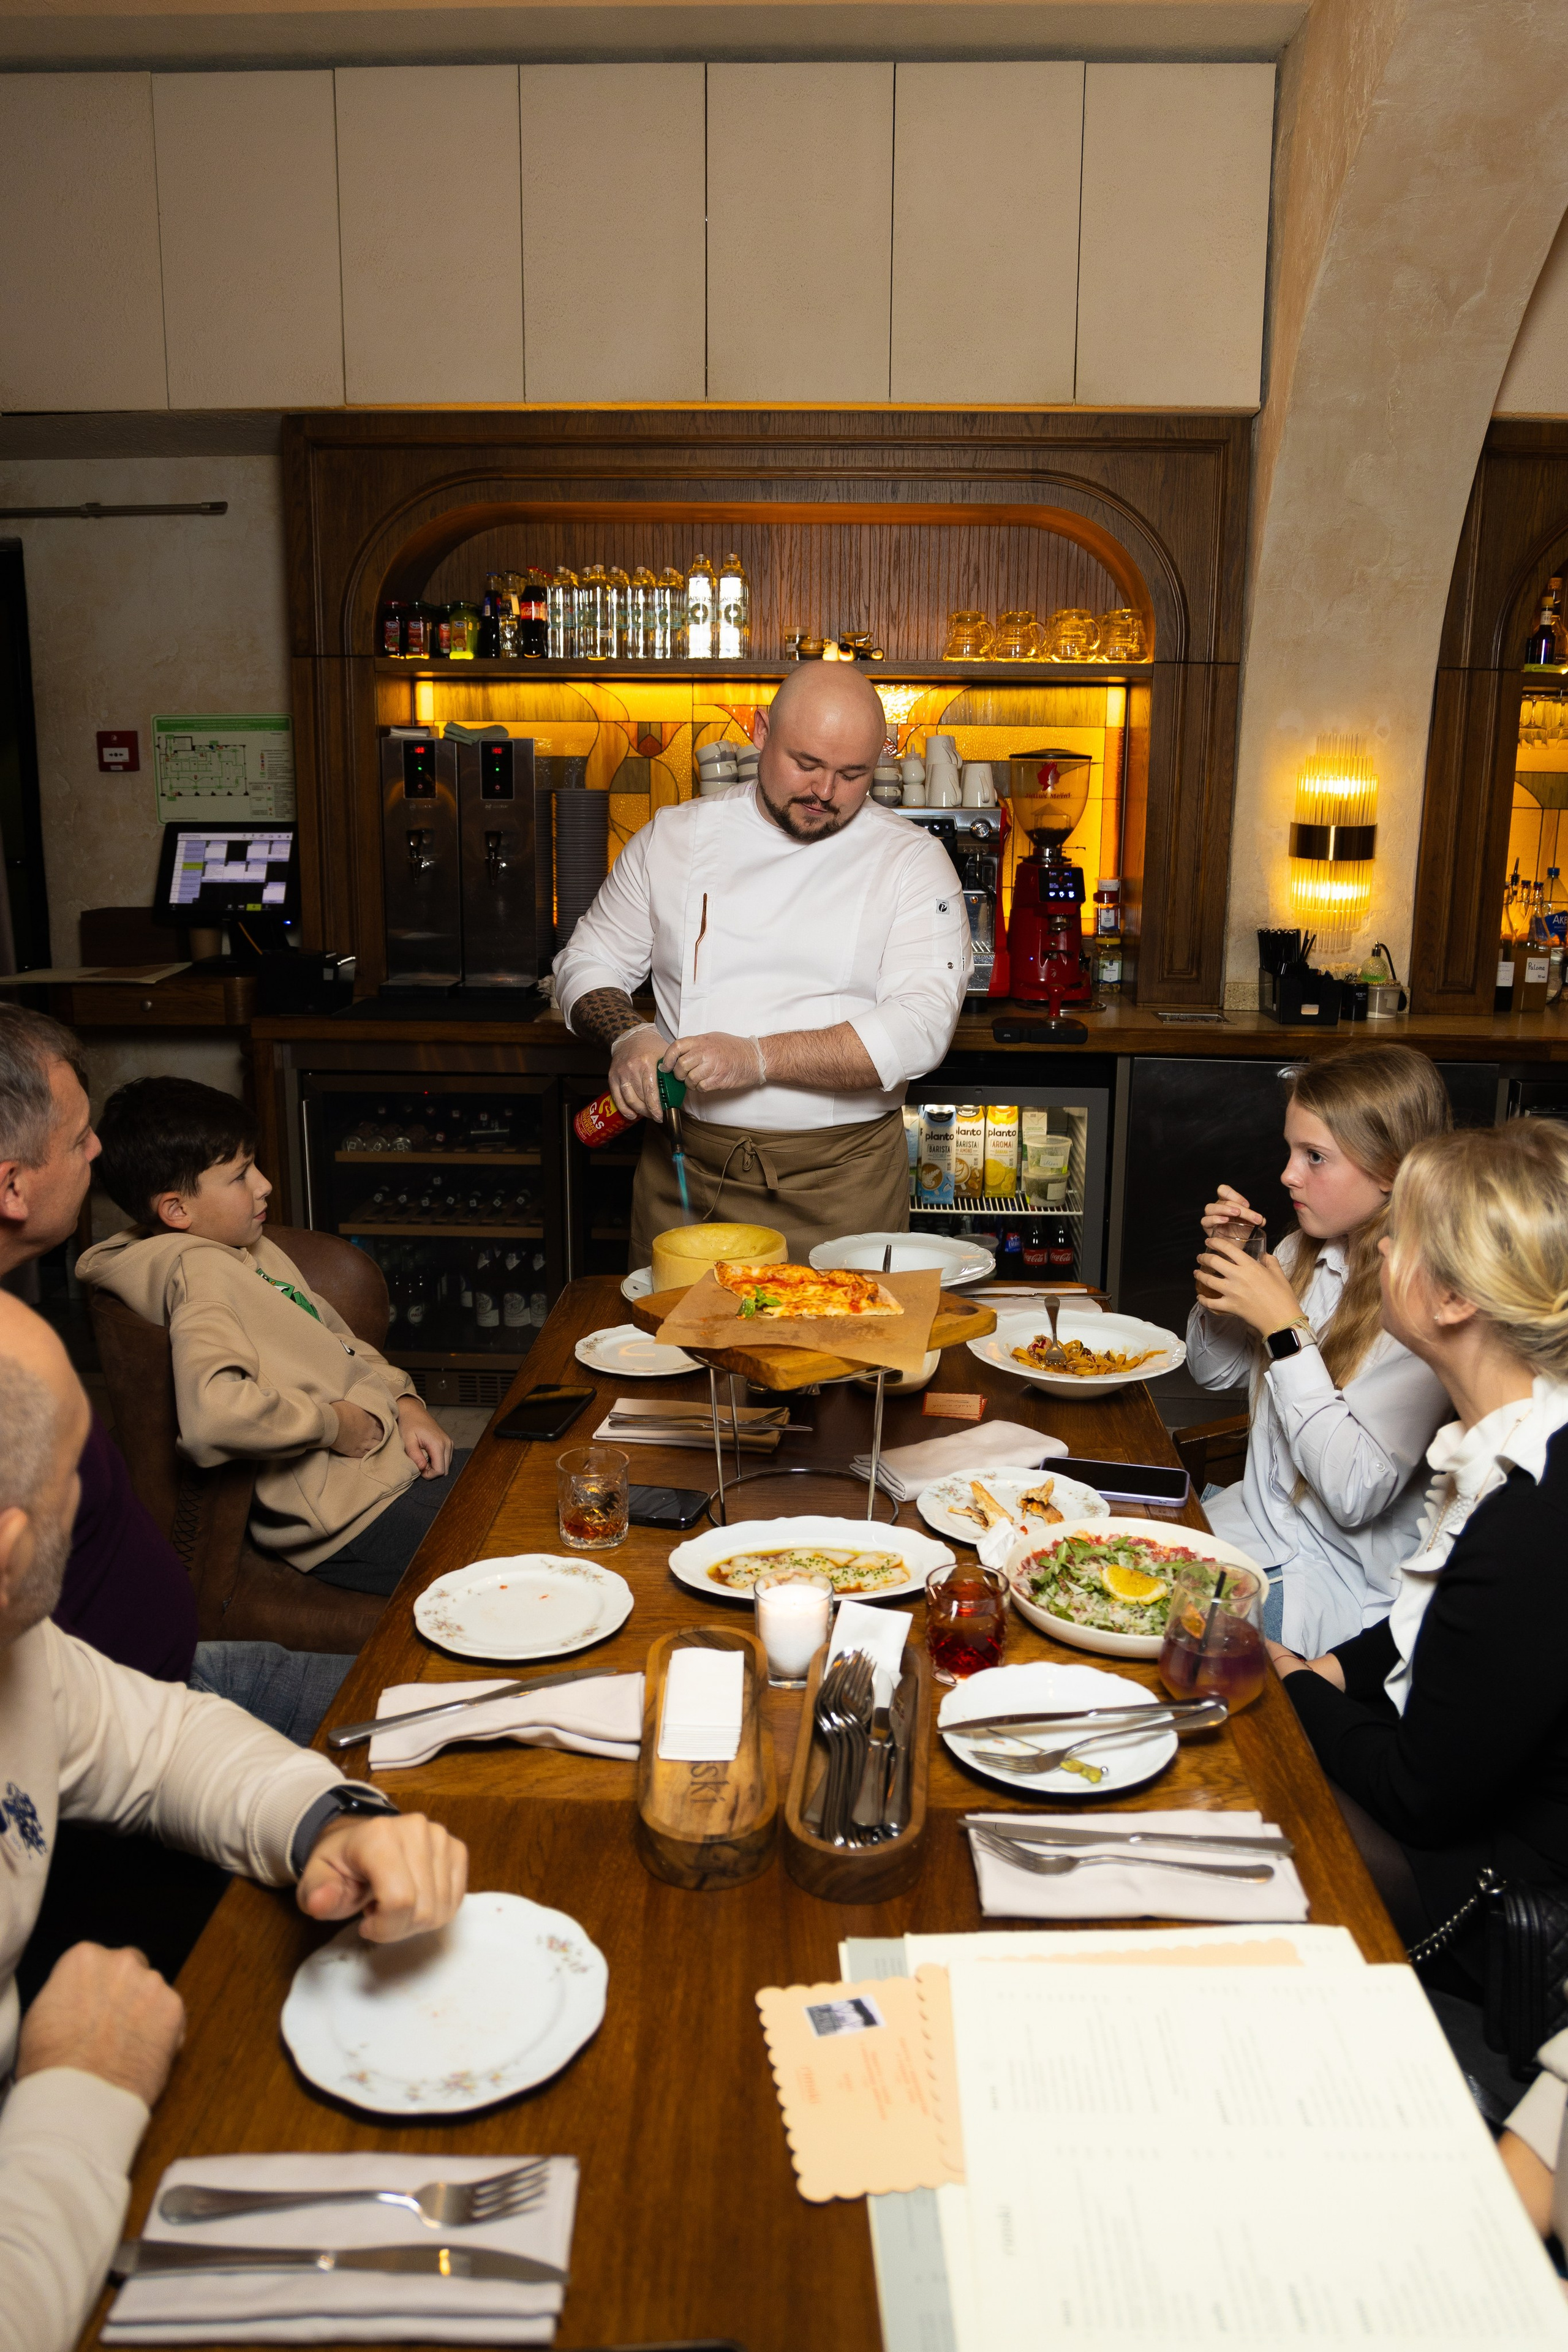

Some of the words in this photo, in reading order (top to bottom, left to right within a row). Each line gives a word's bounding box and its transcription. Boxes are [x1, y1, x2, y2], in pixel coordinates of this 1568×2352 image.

[1528, 962, 1545, 971] Paloma
[590, 1102, 605, 1129] GAS
[925, 1131, 954, 1142] planto
[988, 1128, 1017, 1138] planto
[929, 1145, 950, 1153] BARISTA
[690, 1762, 730, 1804] ski
